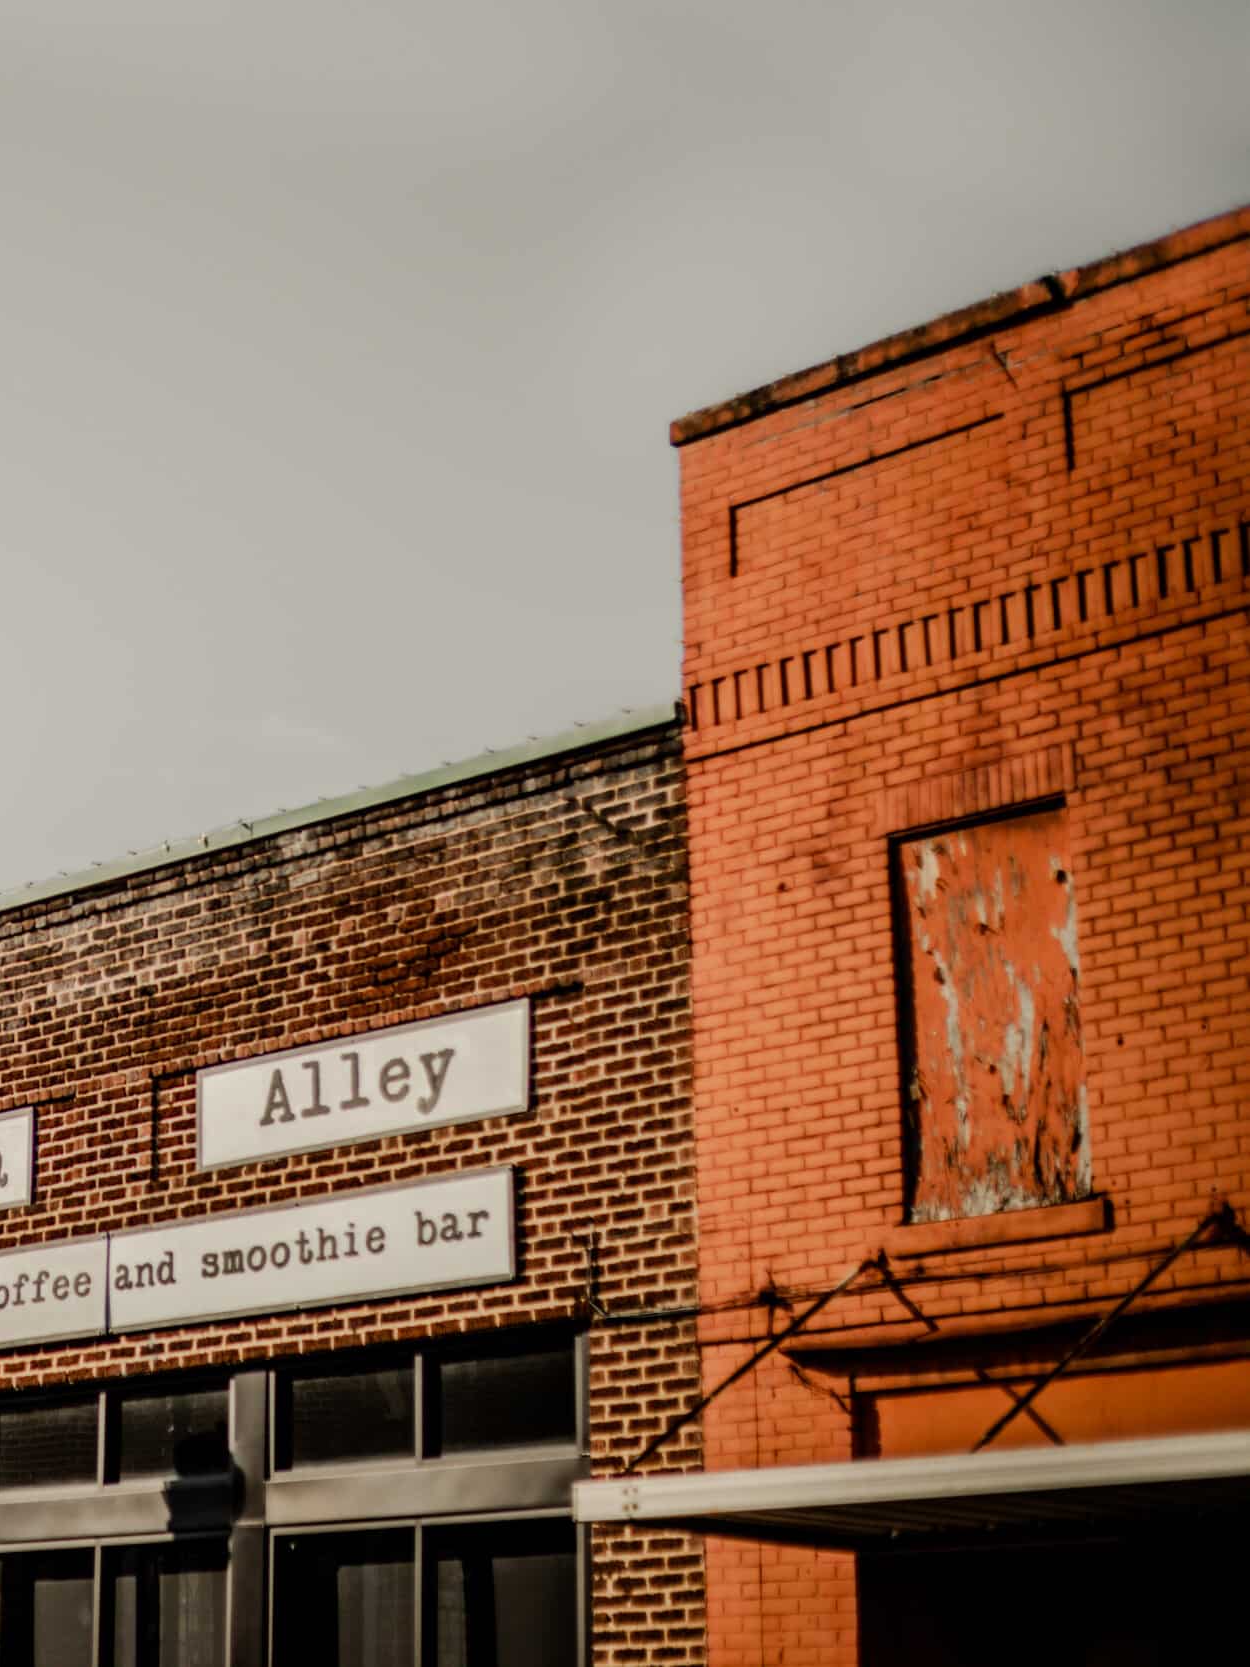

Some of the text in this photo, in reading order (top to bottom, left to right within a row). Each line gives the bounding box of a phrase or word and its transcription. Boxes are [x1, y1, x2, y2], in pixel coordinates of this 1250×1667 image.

[259, 1048, 455, 1127] Alley
[114, 1252, 177, 1291] and
[200, 1222, 387, 1280] smoothie
[414, 1208, 490, 1247] bar
